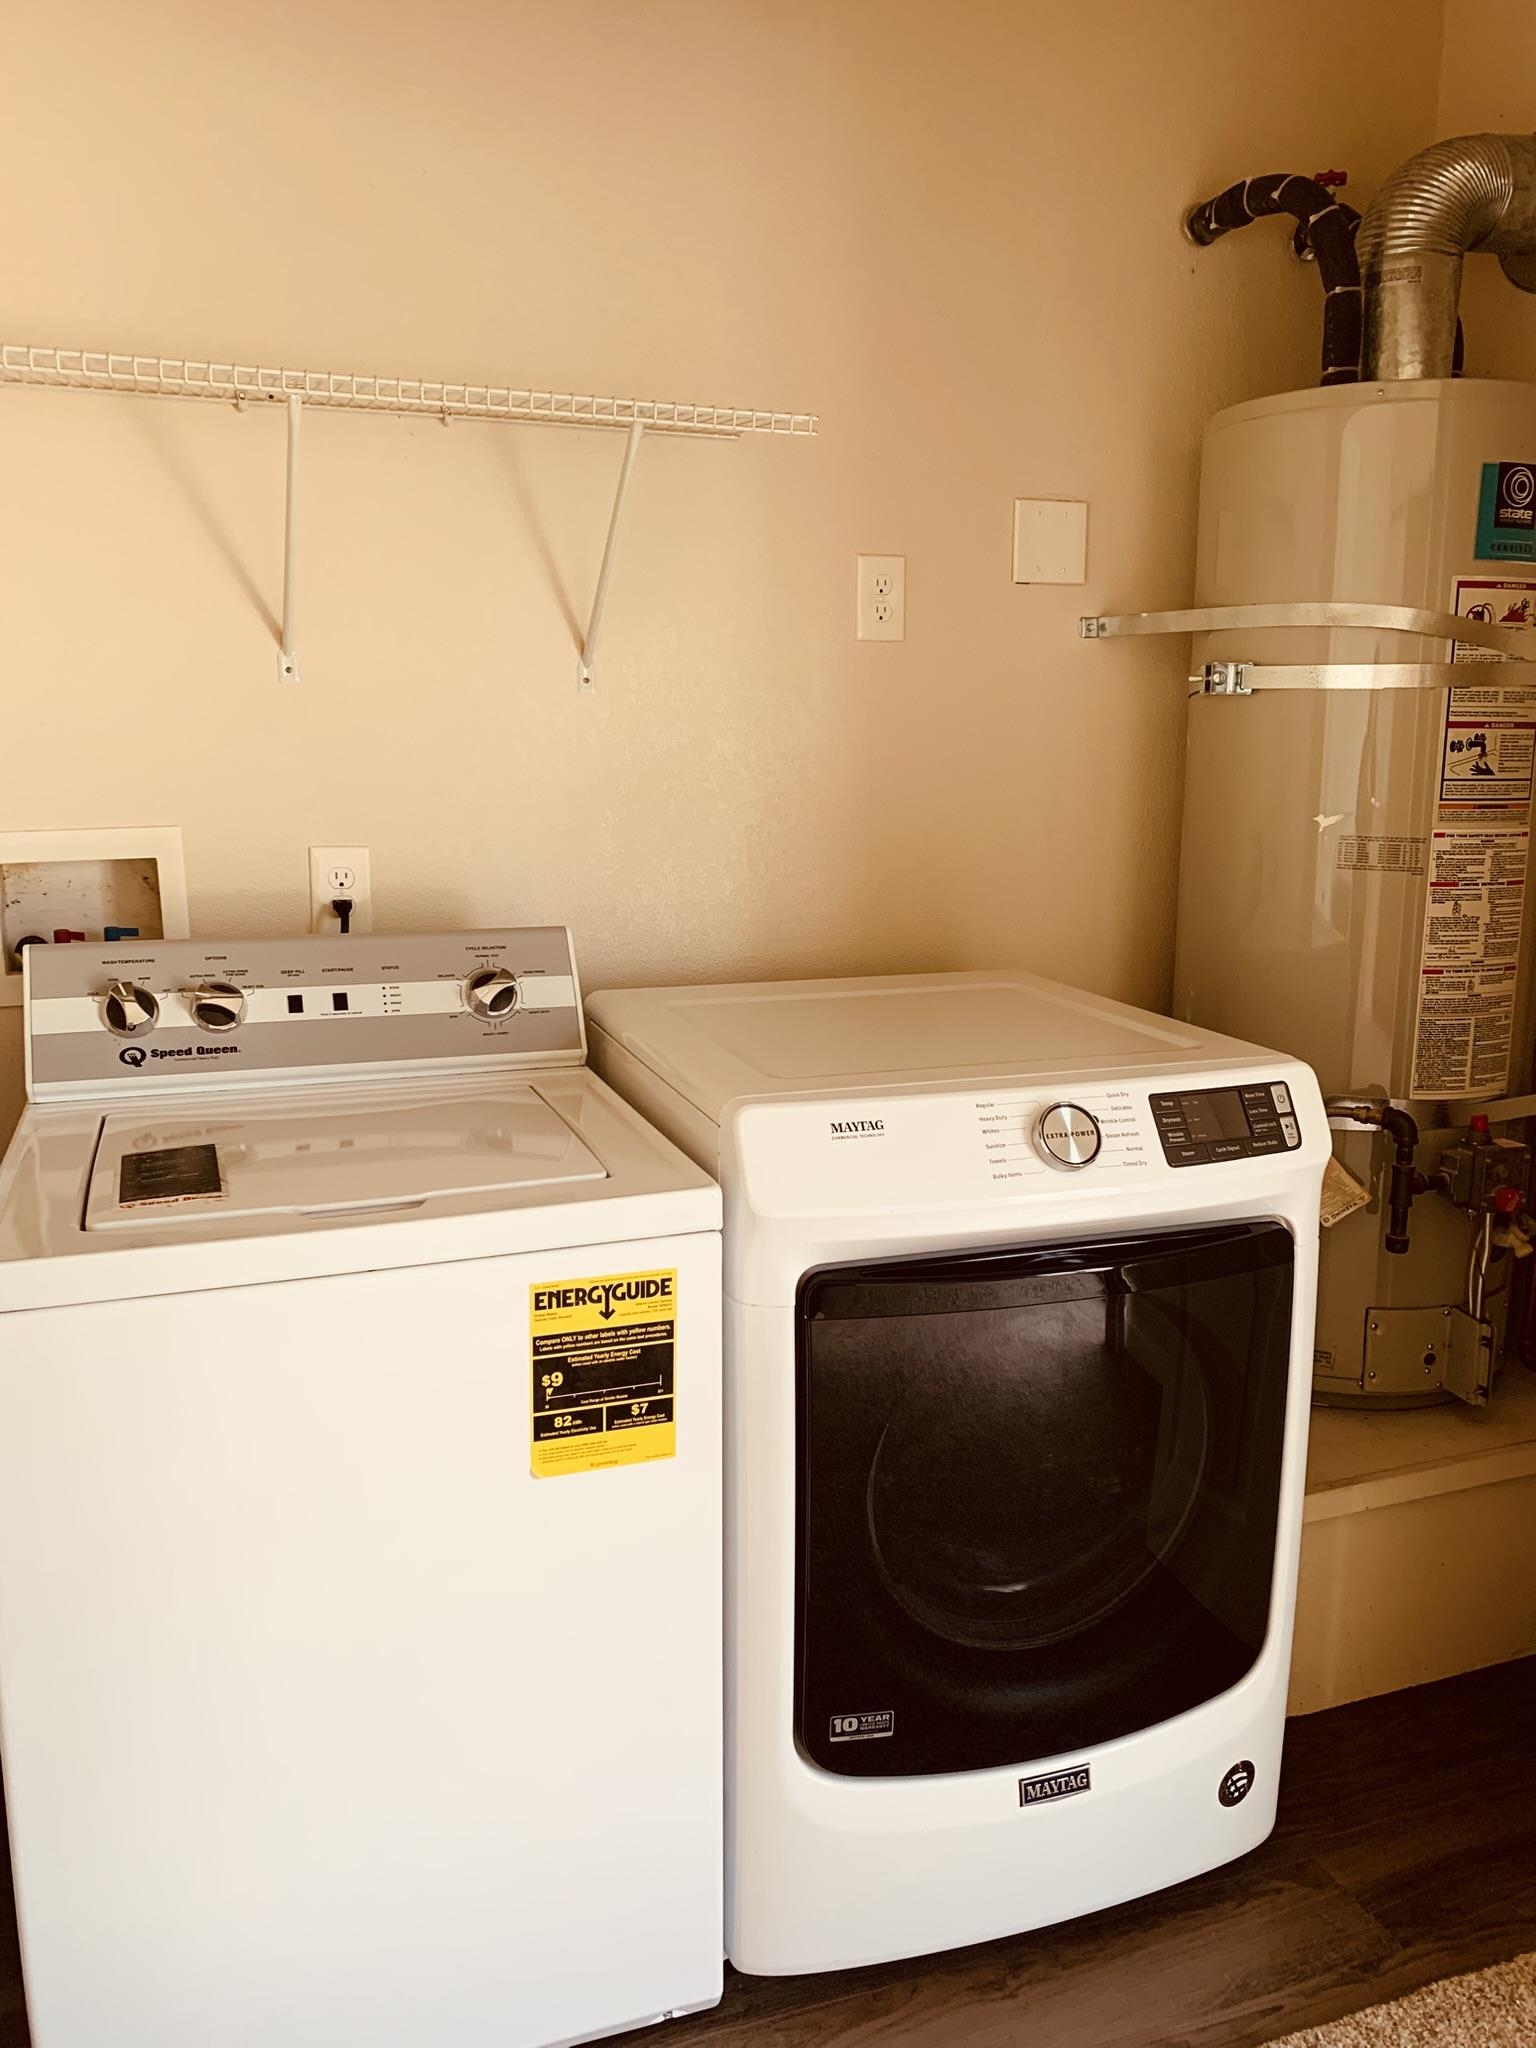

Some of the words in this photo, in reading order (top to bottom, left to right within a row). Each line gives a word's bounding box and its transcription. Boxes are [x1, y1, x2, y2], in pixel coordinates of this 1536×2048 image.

[1500, 508, 1533, 520] state
[150, 1047, 192, 1059] Speed
[196, 1046, 238, 1055] Queen
[830, 1120, 884, 1133] MAYTAG
[534, 1278, 672, 1312] ENERGYGUIDE
[535, 1337, 560, 1347] Compare
[562, 1335, 577, 1343] ONLY
[629, 1327, 646, 1336] yellow
[647, 1324, 671, 1333] numbers.
[541, 1372, 563, 1387] $9
[631, 1403, 648, 1416] $7
[554, 1415, 572, 1428] 82
[834, 1717, 858, 1733] 10
[861, 1714, 890, 1722] YEAR
[1026, 1773, 1088, 1800] MAYTAG
